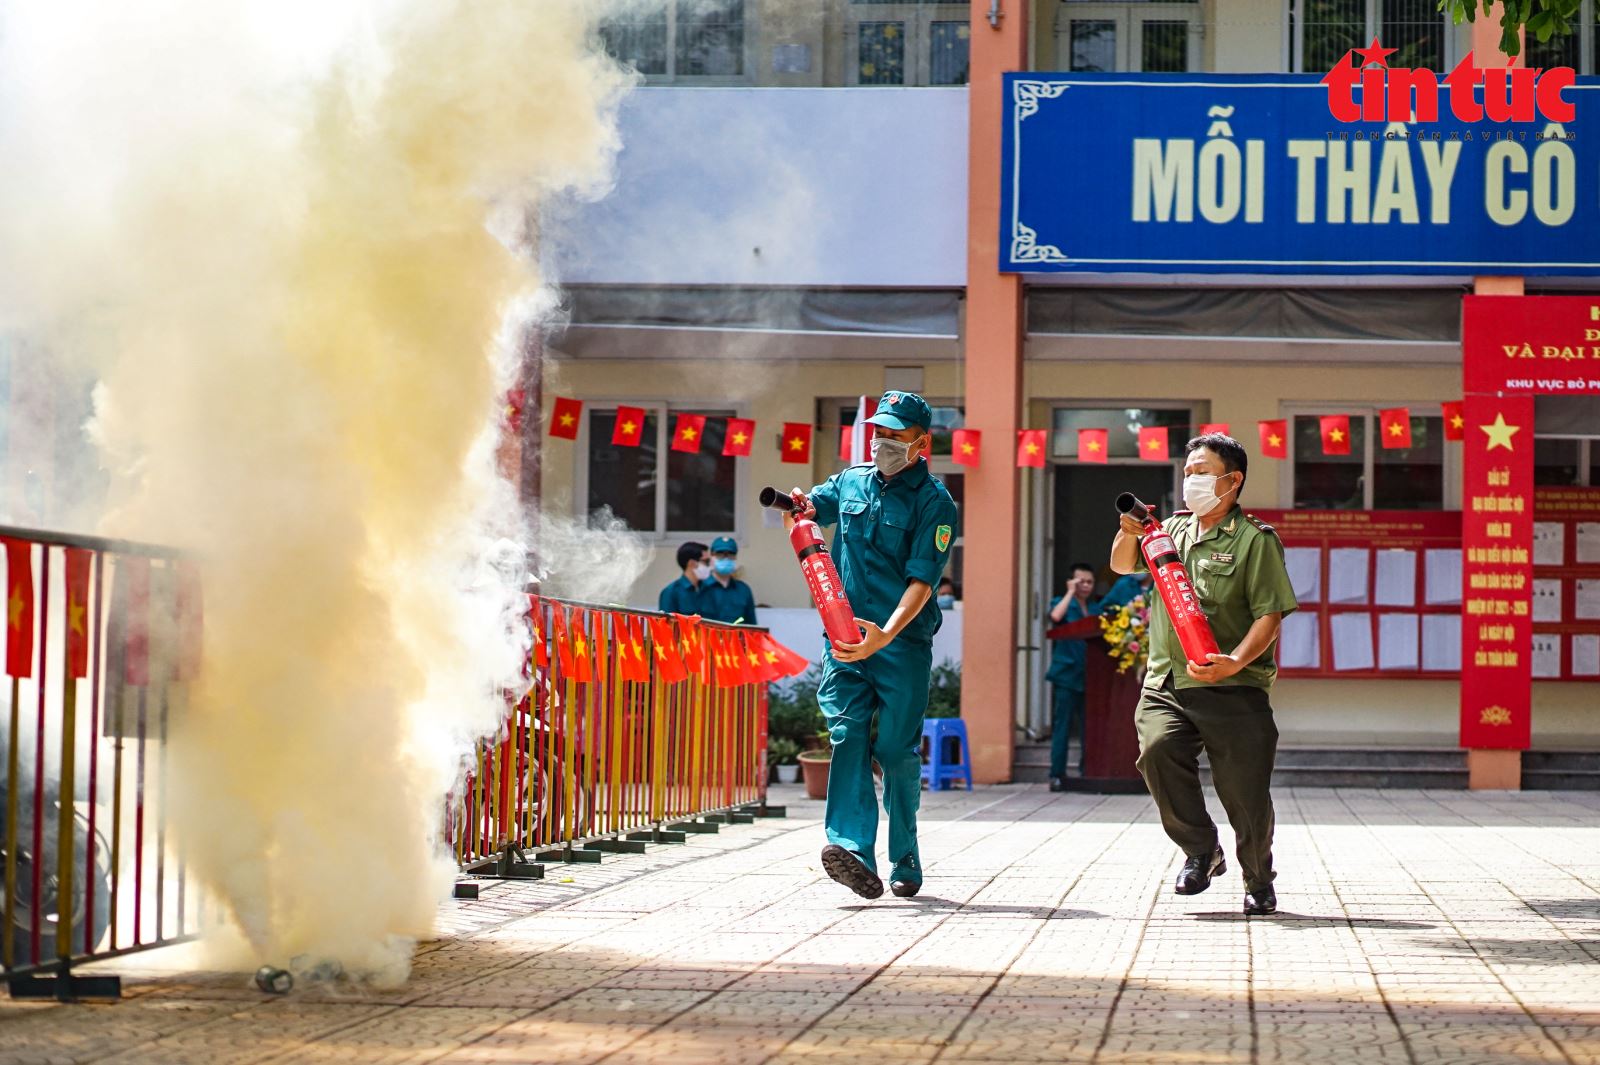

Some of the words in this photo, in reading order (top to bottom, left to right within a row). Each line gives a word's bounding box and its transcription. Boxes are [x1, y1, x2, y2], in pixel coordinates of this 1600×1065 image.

[1131, 104, 1264, 224] MỖI
[1485, 122, 1576, 226] CÔ
[1502, 342, 1536, 358] VÀ
[1541, 345, 1586, 362] ĐẠI
[1506, 379, 1534, 389] KHU
[1537, 379, 1565, 391] VỰC
